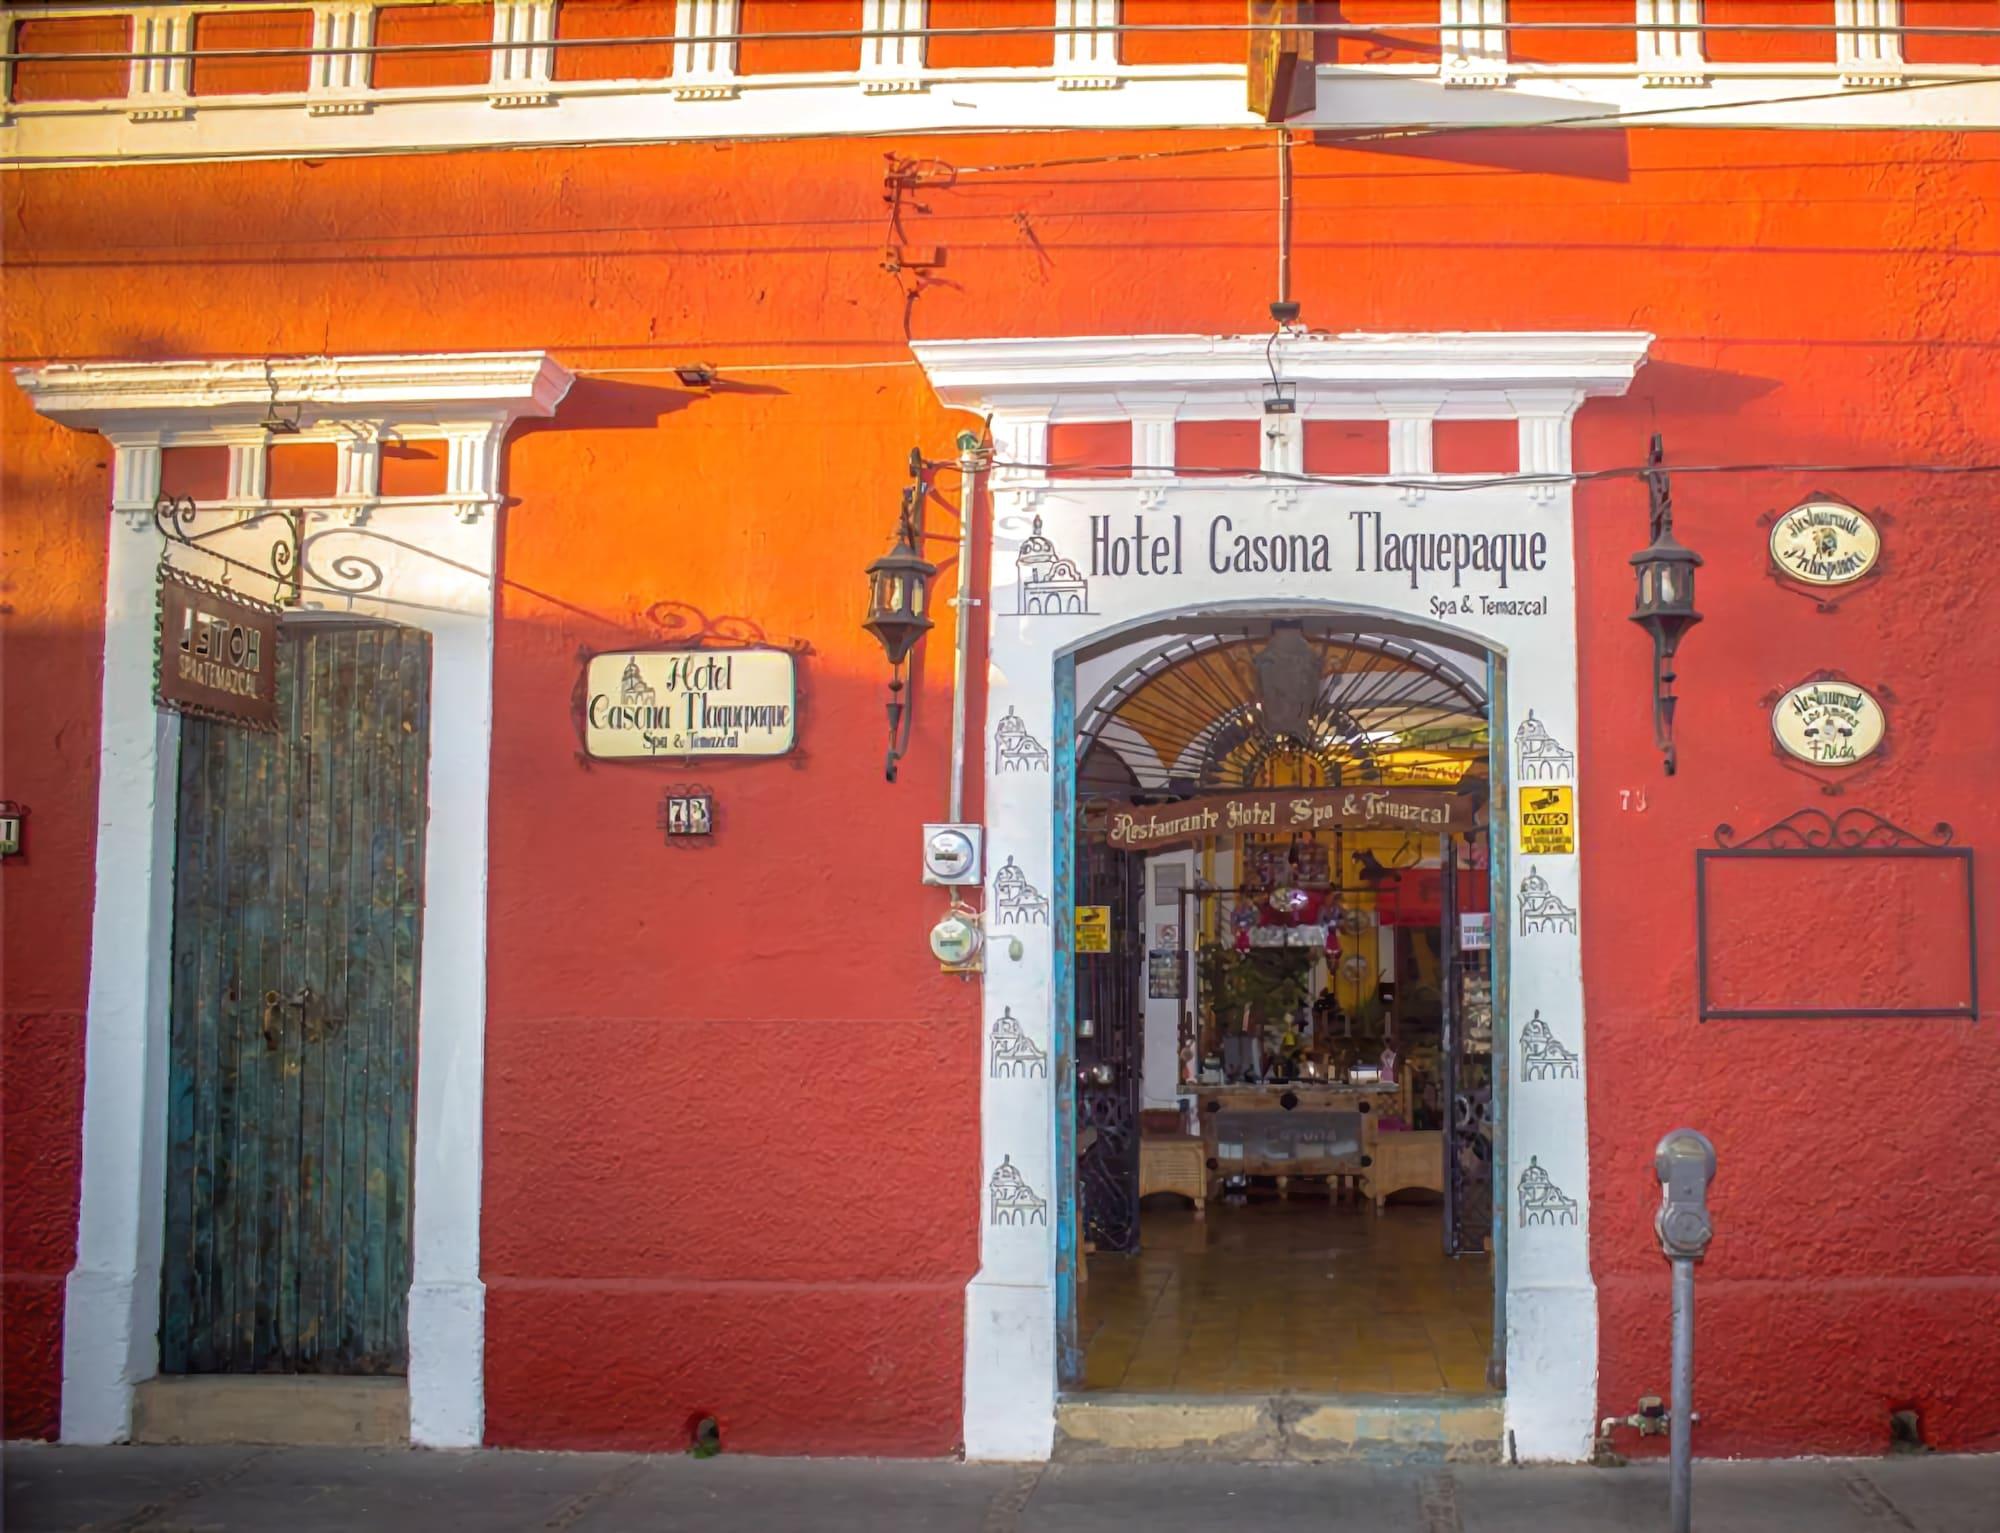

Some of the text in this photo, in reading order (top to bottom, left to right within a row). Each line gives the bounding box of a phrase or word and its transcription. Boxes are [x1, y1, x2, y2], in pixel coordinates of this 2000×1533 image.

[1089, 511, 1547, 589] Hotel Casona Tlaquepaque
[1429, 595, 1548, 619] Spa & Temazcal
[666, 655, 732, 692] Hotel
[589, 692, 790, 735] Casona Tlaquepaque
[642, 731, 668, 754] Spa
[673, 733, 685, 749] &
[1807, 738, 1856, 761] Frida
[1110, 790, 1451, 844] Restaurante Hotel Spa & Temazcal
